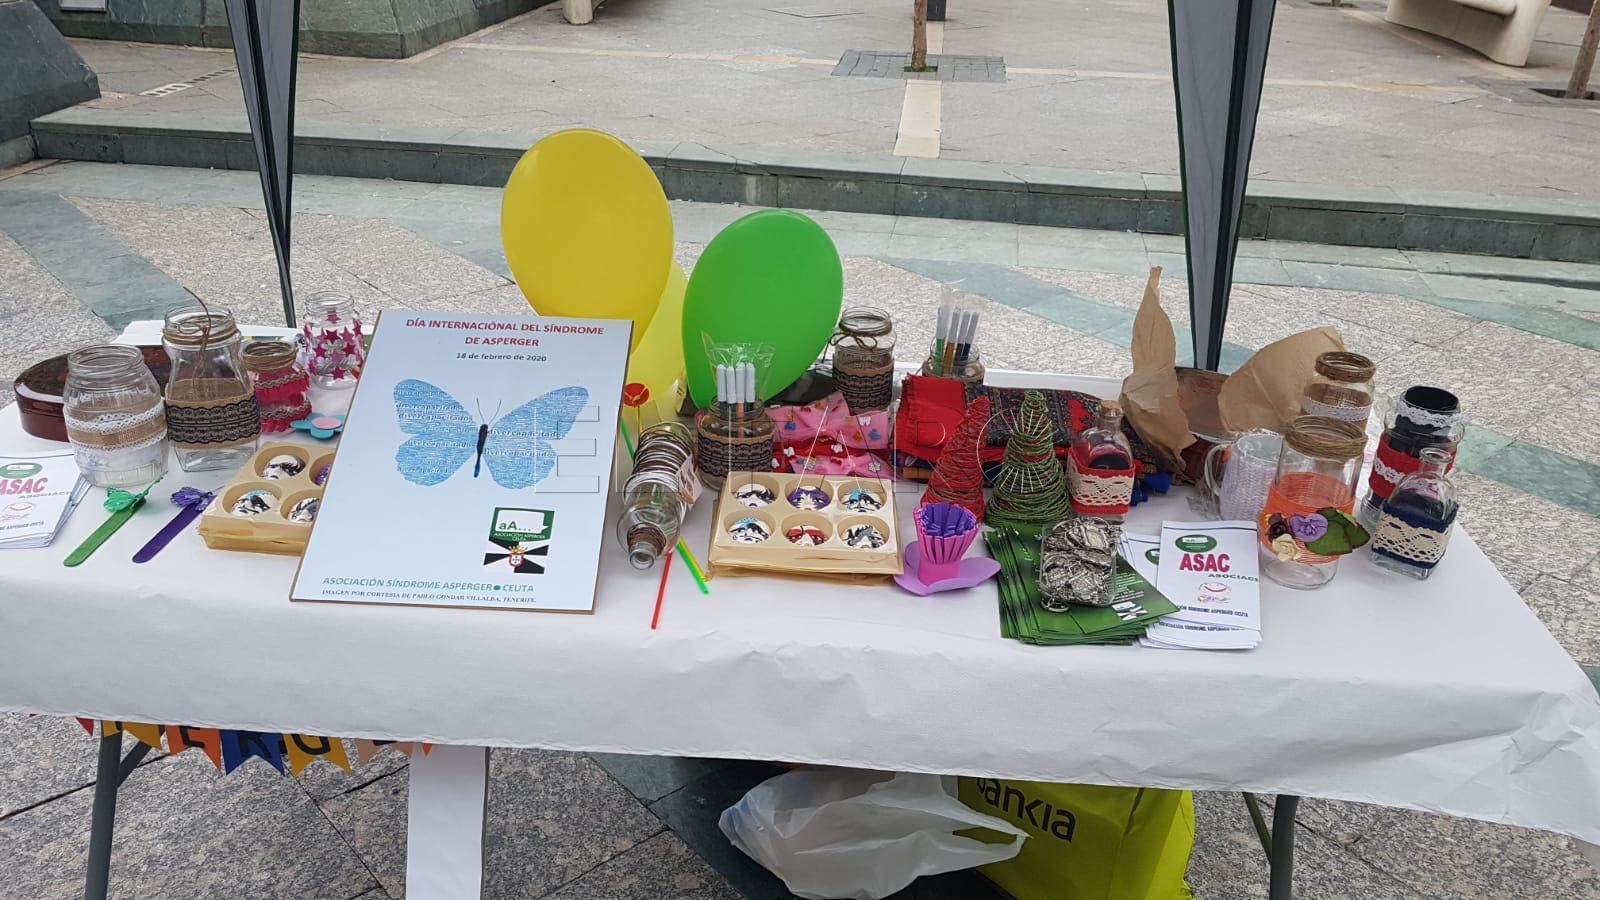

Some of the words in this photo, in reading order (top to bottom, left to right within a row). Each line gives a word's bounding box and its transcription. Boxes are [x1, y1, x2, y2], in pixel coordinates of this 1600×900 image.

[406, 318, 426, 328] DÍA
[521, 323, 541, 332] DEL
[543, 323, 605, 335] SÍNDROME
[465, 336, 480, 345] DE
[482, 337, 540, 347] ASPERGER
[481, 353, 512, 361] febrero
[1179, 553, 1231, 573] ASAC
[386, 578, 441, 589] SÍNDROME
[442, 582, 492, 592] ASPERGER
[503, 584, 534, 593] CEUTA
